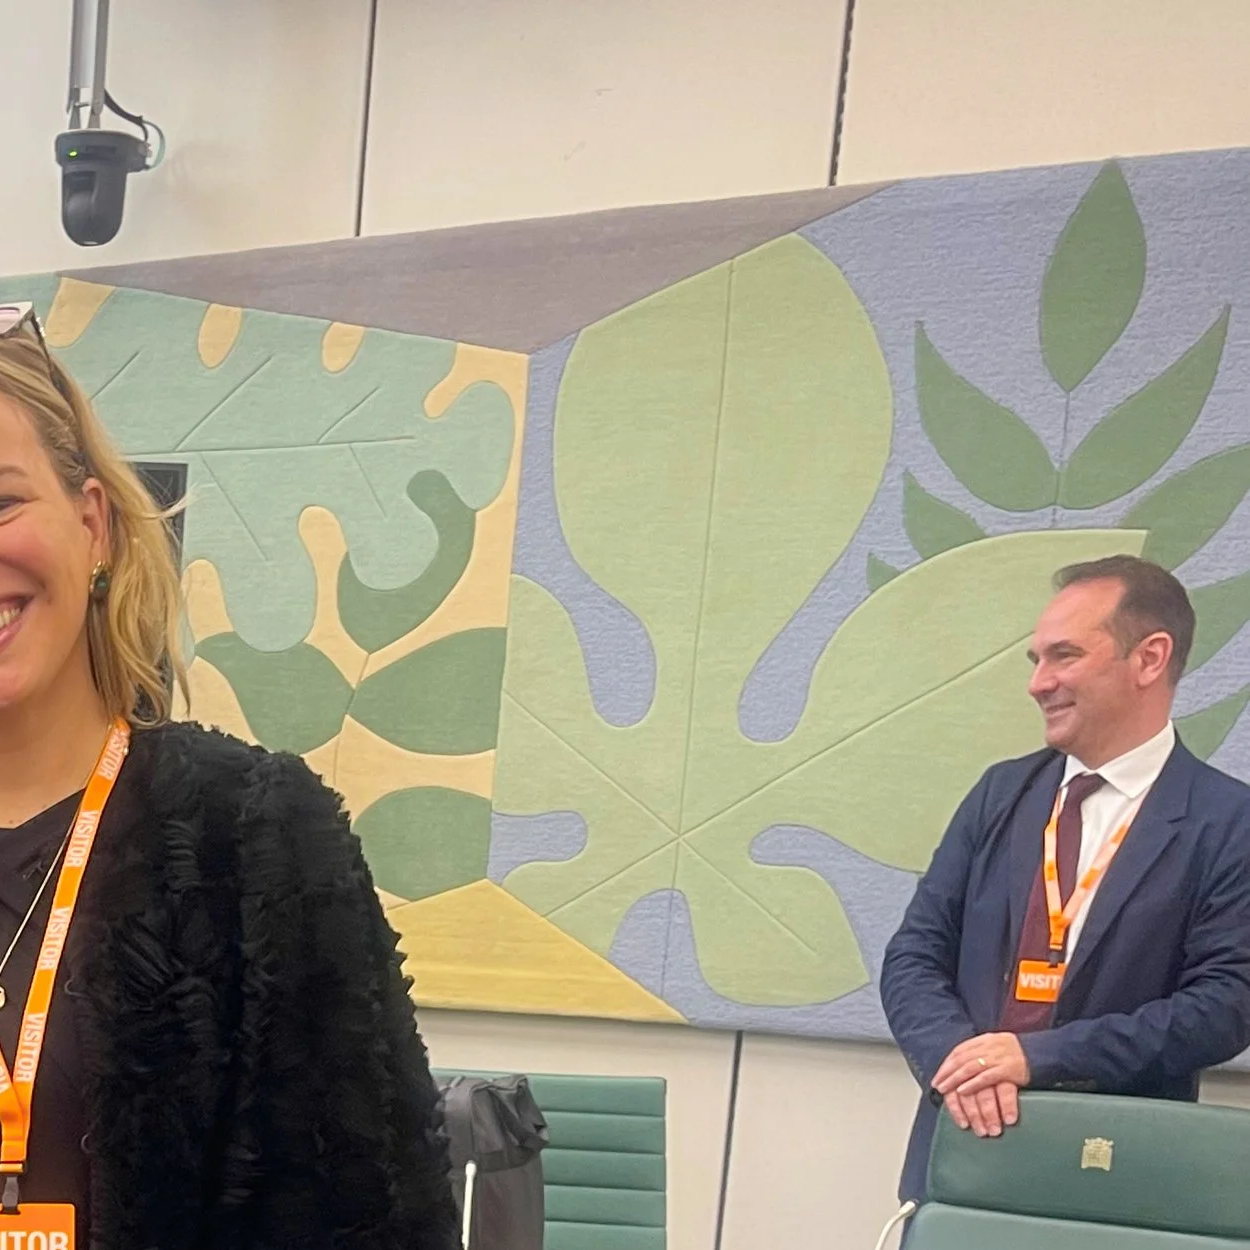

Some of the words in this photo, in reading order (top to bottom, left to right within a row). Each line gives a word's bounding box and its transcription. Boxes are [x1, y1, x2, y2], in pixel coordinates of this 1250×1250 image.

[65, 810, 100, 868] VISITOR
[37, 906, 71, 970] VISITOR
[1020, 973, 1061, 989] VISIT
[16, 1012, 45, 1082] VISITOR
